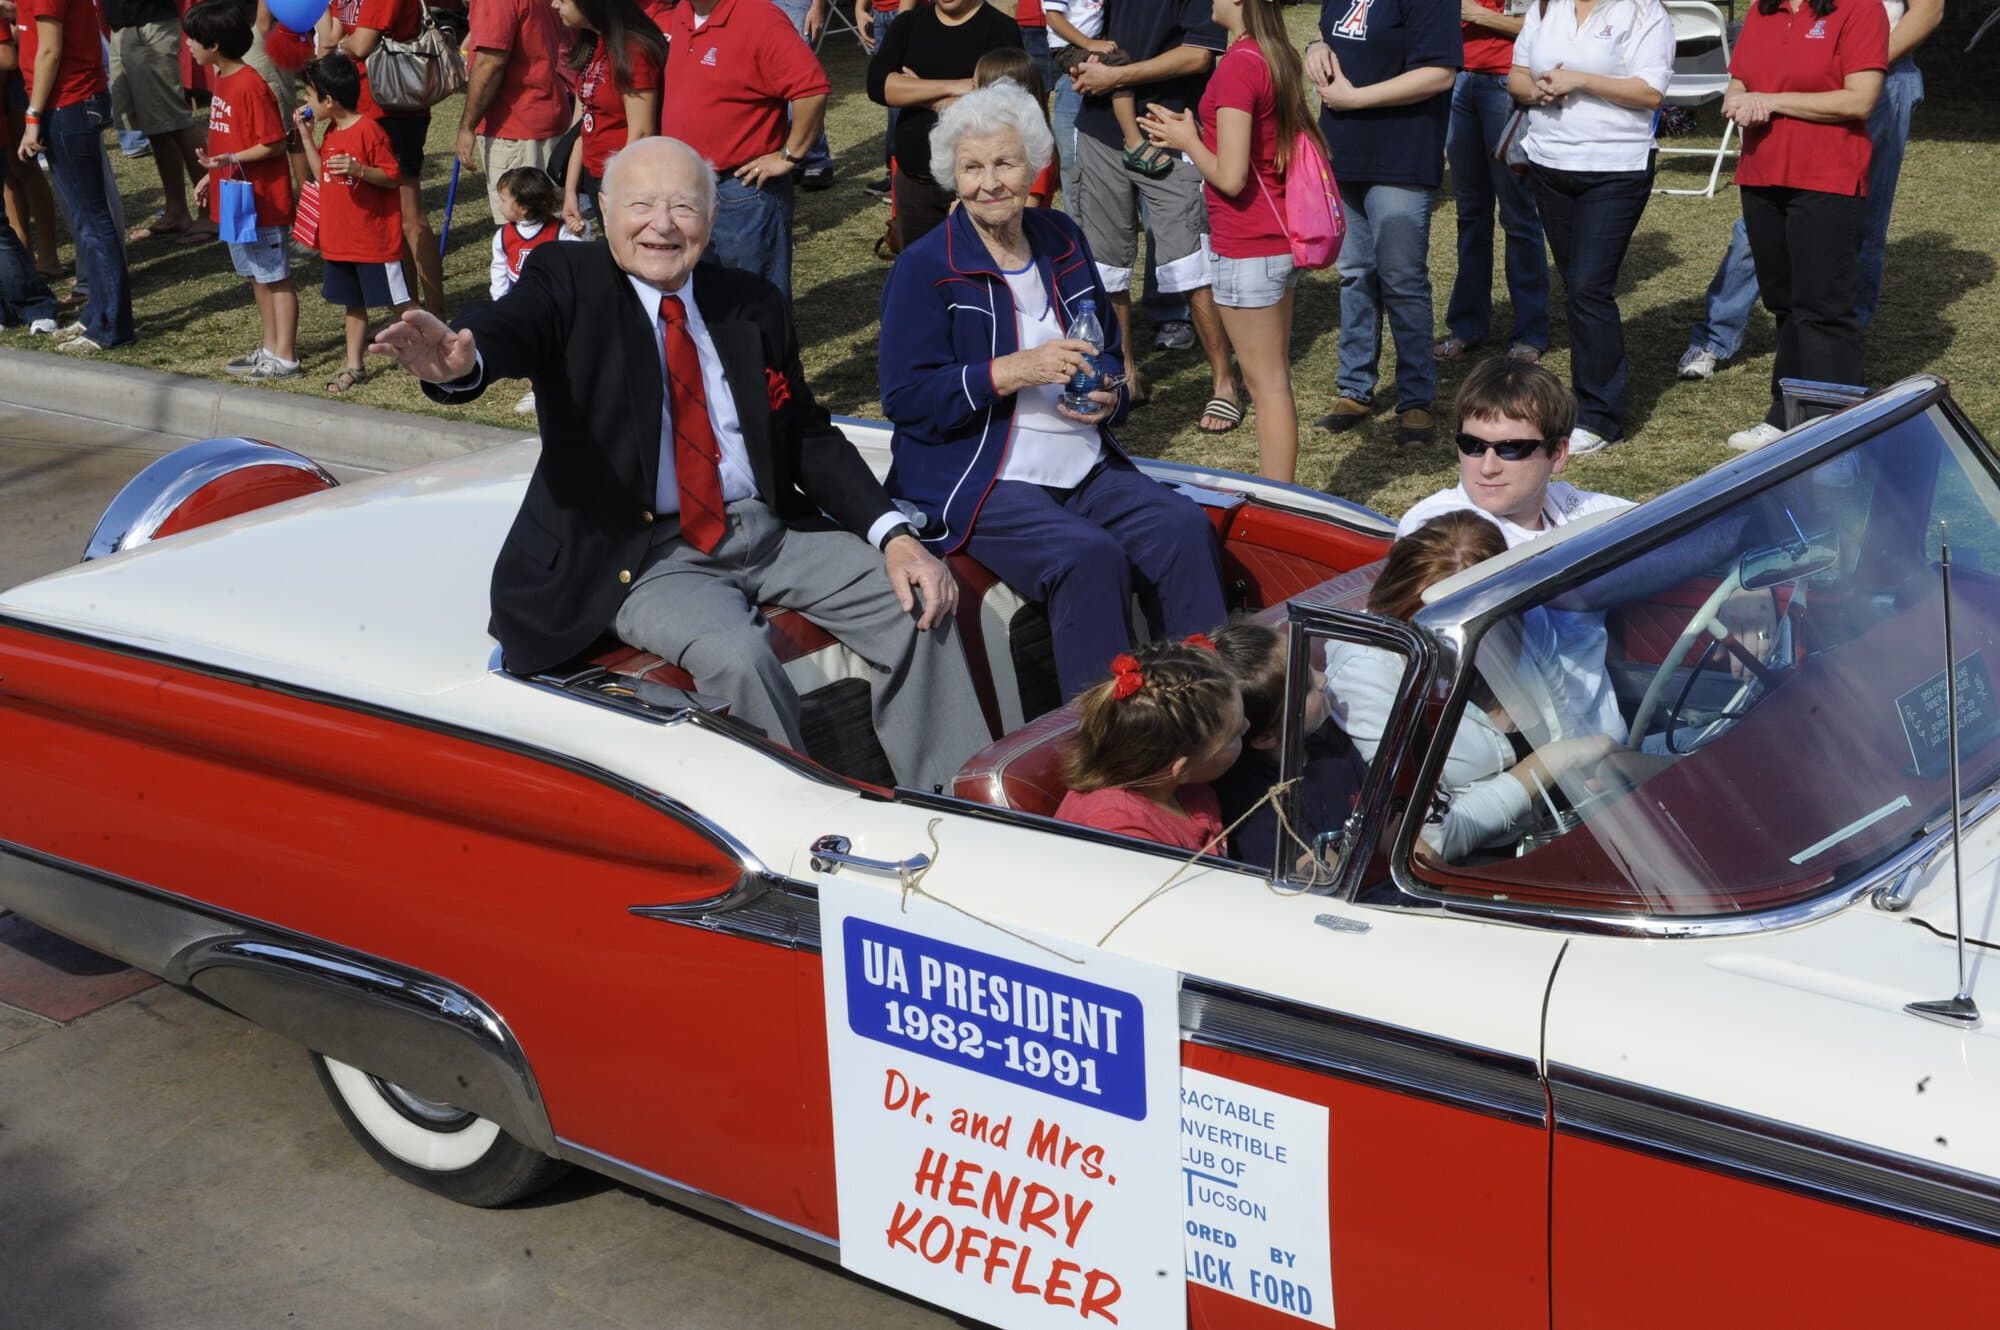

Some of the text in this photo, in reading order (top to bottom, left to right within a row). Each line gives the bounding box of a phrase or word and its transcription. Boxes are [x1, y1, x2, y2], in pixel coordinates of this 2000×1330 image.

[862, 938, 1122, 1055] UA PRESIDENT
[885, 1000, 1102, 1095] 1982-1991
[884, 1069, 1116, 1185] Dr. and Mrs.
[1221, 1157, 1247, 1177] OF
[915, 1147, 1094, 1248] HENRY
[1185, 1220, 1297, 1268] ORED BY
[887, 1202, 1122, 1325] KOFFLER
[1250, 1269, 1313, 1316] FORD
